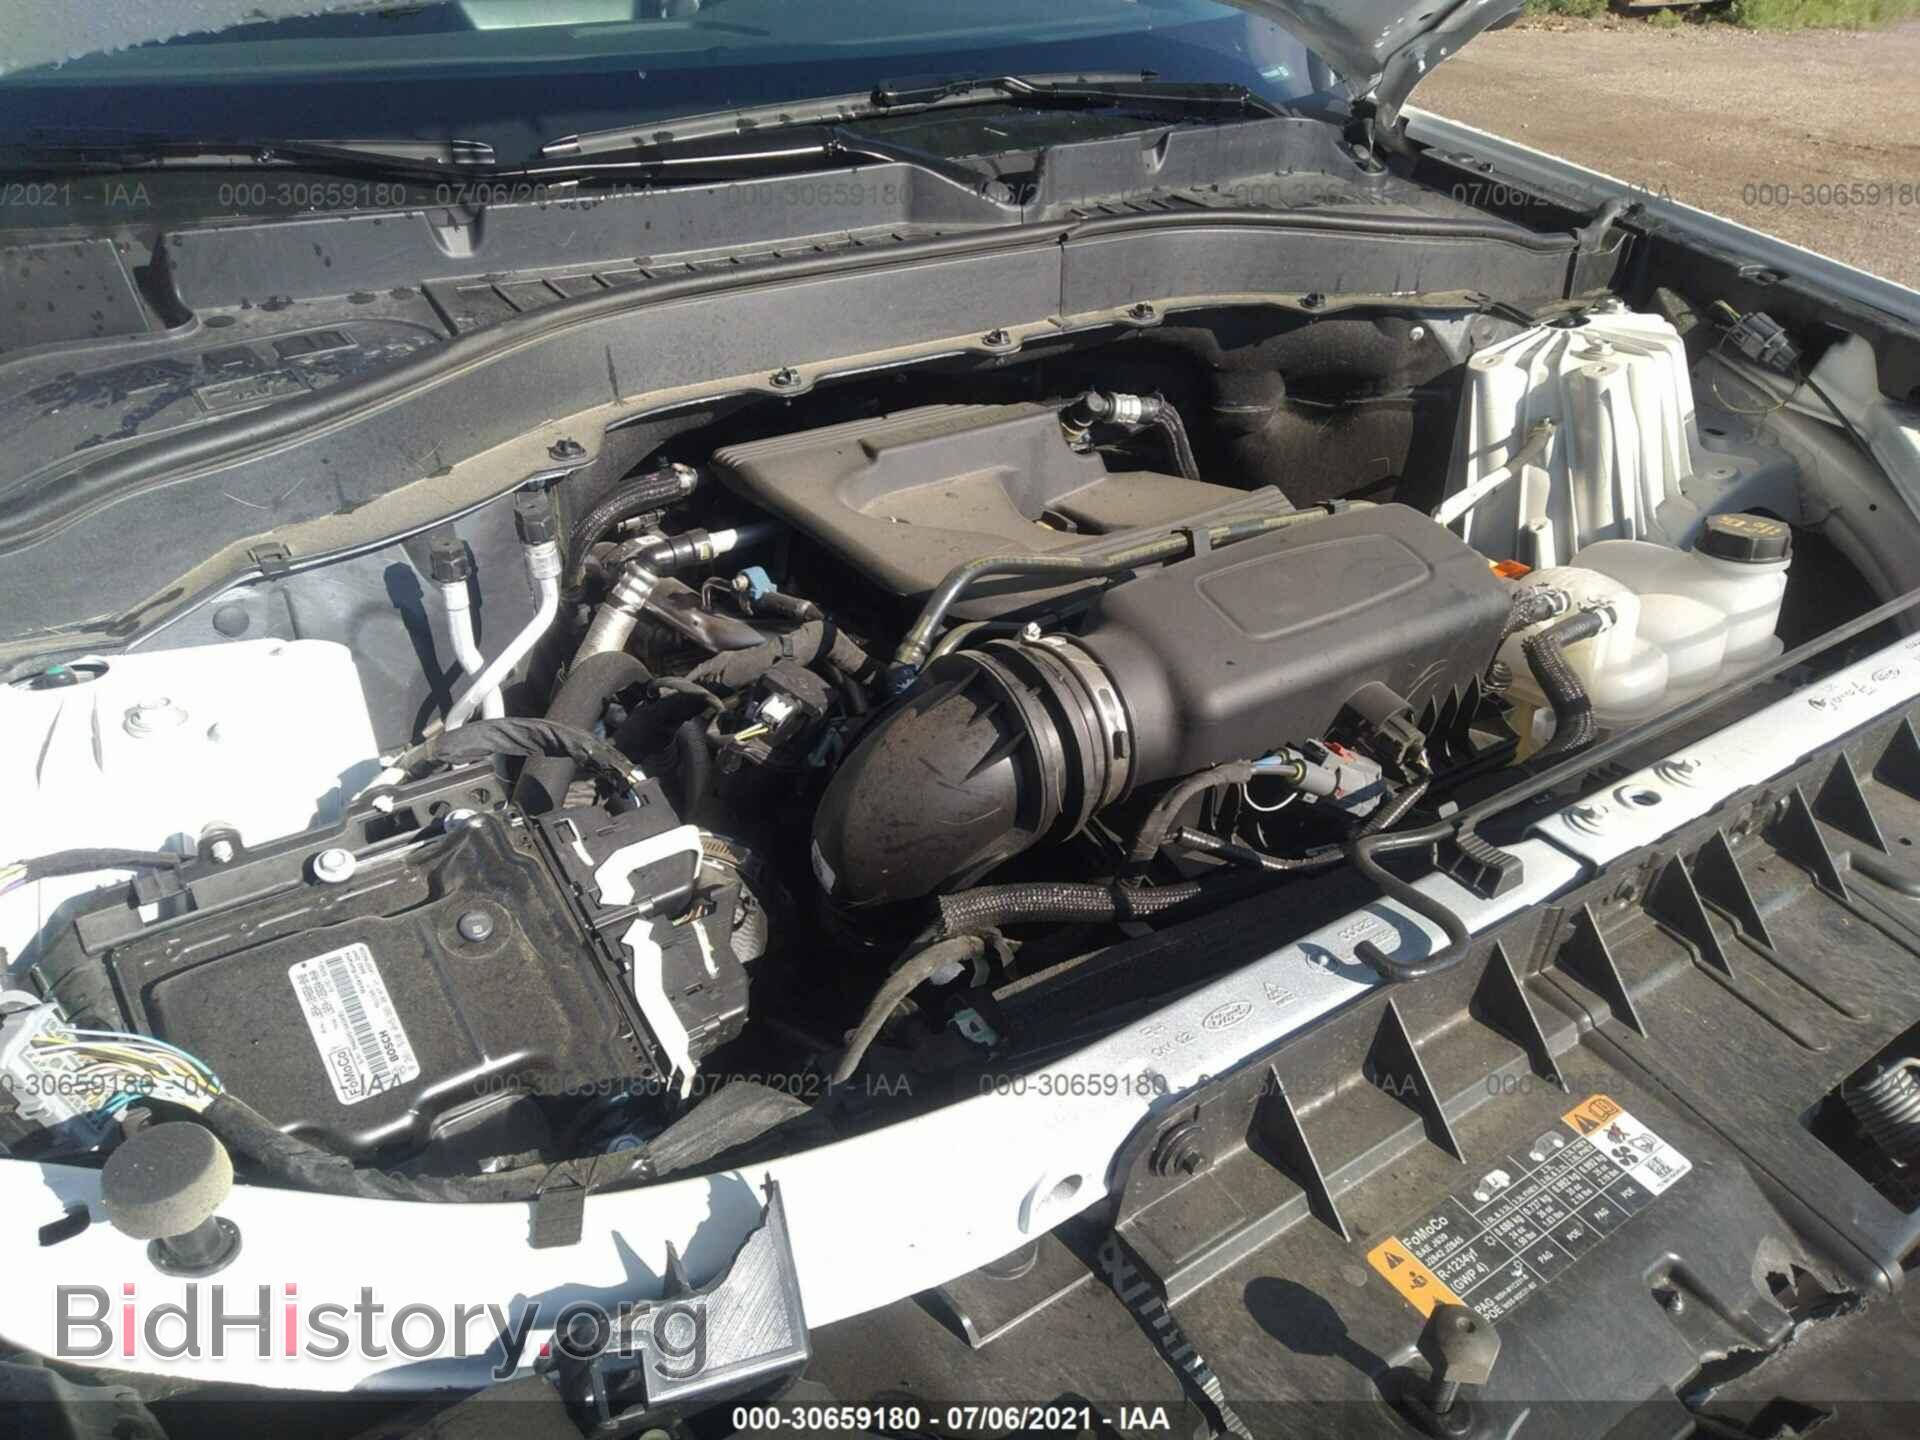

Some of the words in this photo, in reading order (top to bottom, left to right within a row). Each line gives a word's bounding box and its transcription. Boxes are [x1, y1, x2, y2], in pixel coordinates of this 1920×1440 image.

[379, 1030, 400, 1063] BOSCH
[337, 1051, 361, 1096] FoMoCo
[1402, 1216, 1449, 1249] FoMoCo
[1566, 1228, 1582, 1242] POE
[1436, 1247, 1479, 1281] R-1234yf
[1537, 1250, 1554, 1264] PAG
[1449, 1268, 1477, 1294] (GWP
[1475, 1261, 1490, 1273] 4)
[1474, 1297, 1495, 1315] PAG
[1483, 1304, 1504, 1323] POE
